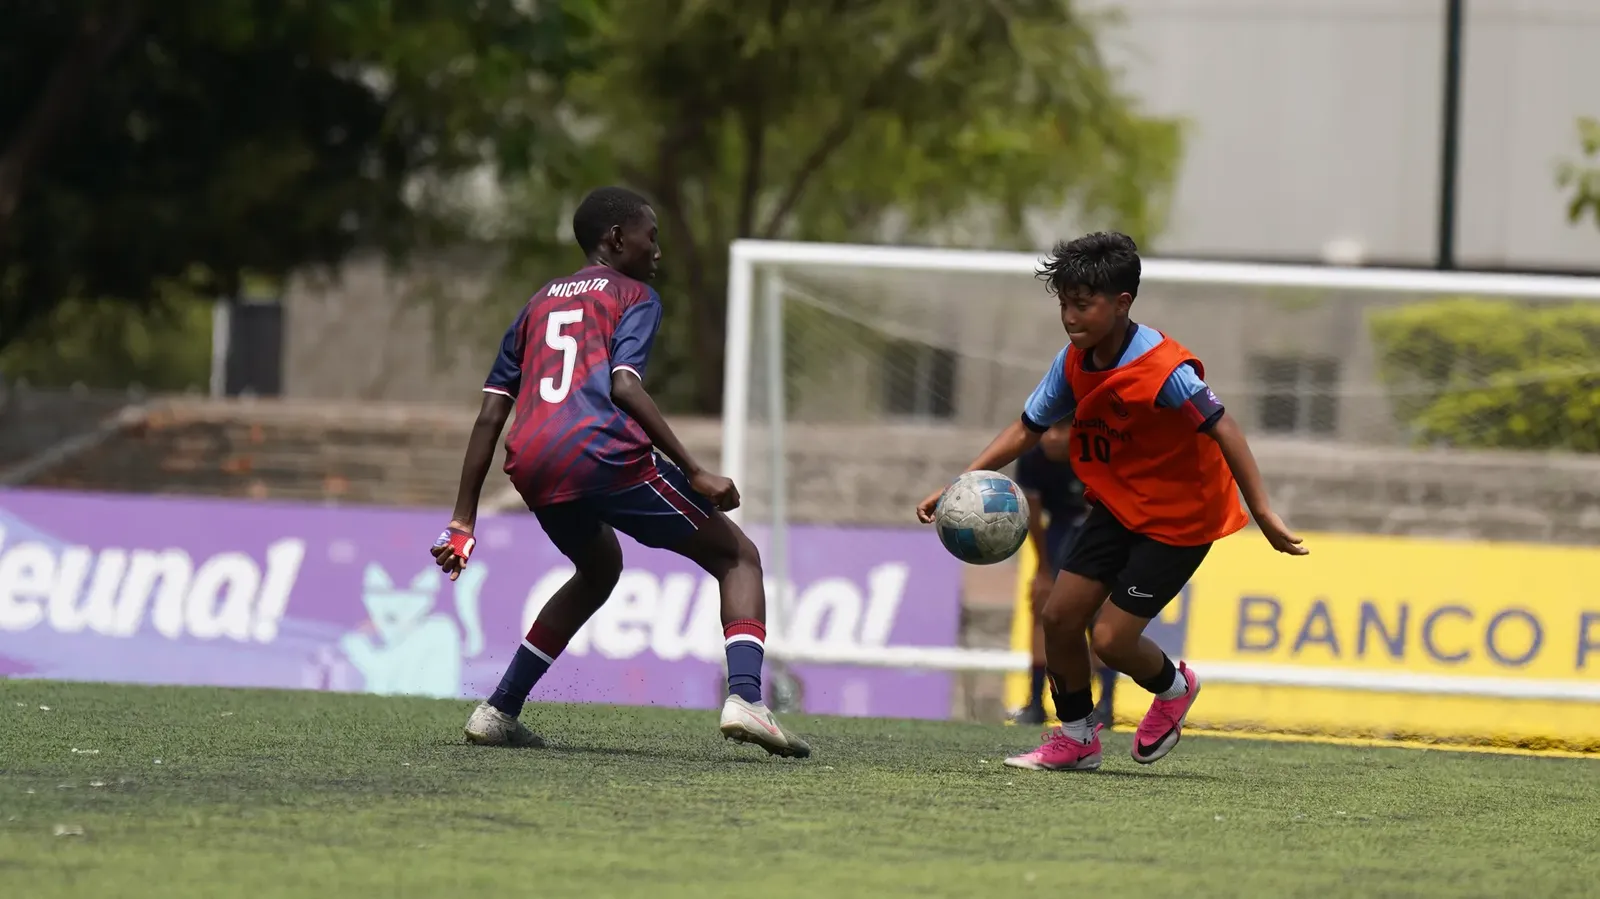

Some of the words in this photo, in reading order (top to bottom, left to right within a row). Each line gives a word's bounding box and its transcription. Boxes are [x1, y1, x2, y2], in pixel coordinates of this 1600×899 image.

[547, 278, 609, 298] MICOLTA
[540, 308, 584, 404] 5
[1076, 431, 1111, 464] 10
[0, 527, 305, 642] euna!
[1236, 595, 1544, 668] BANCO
